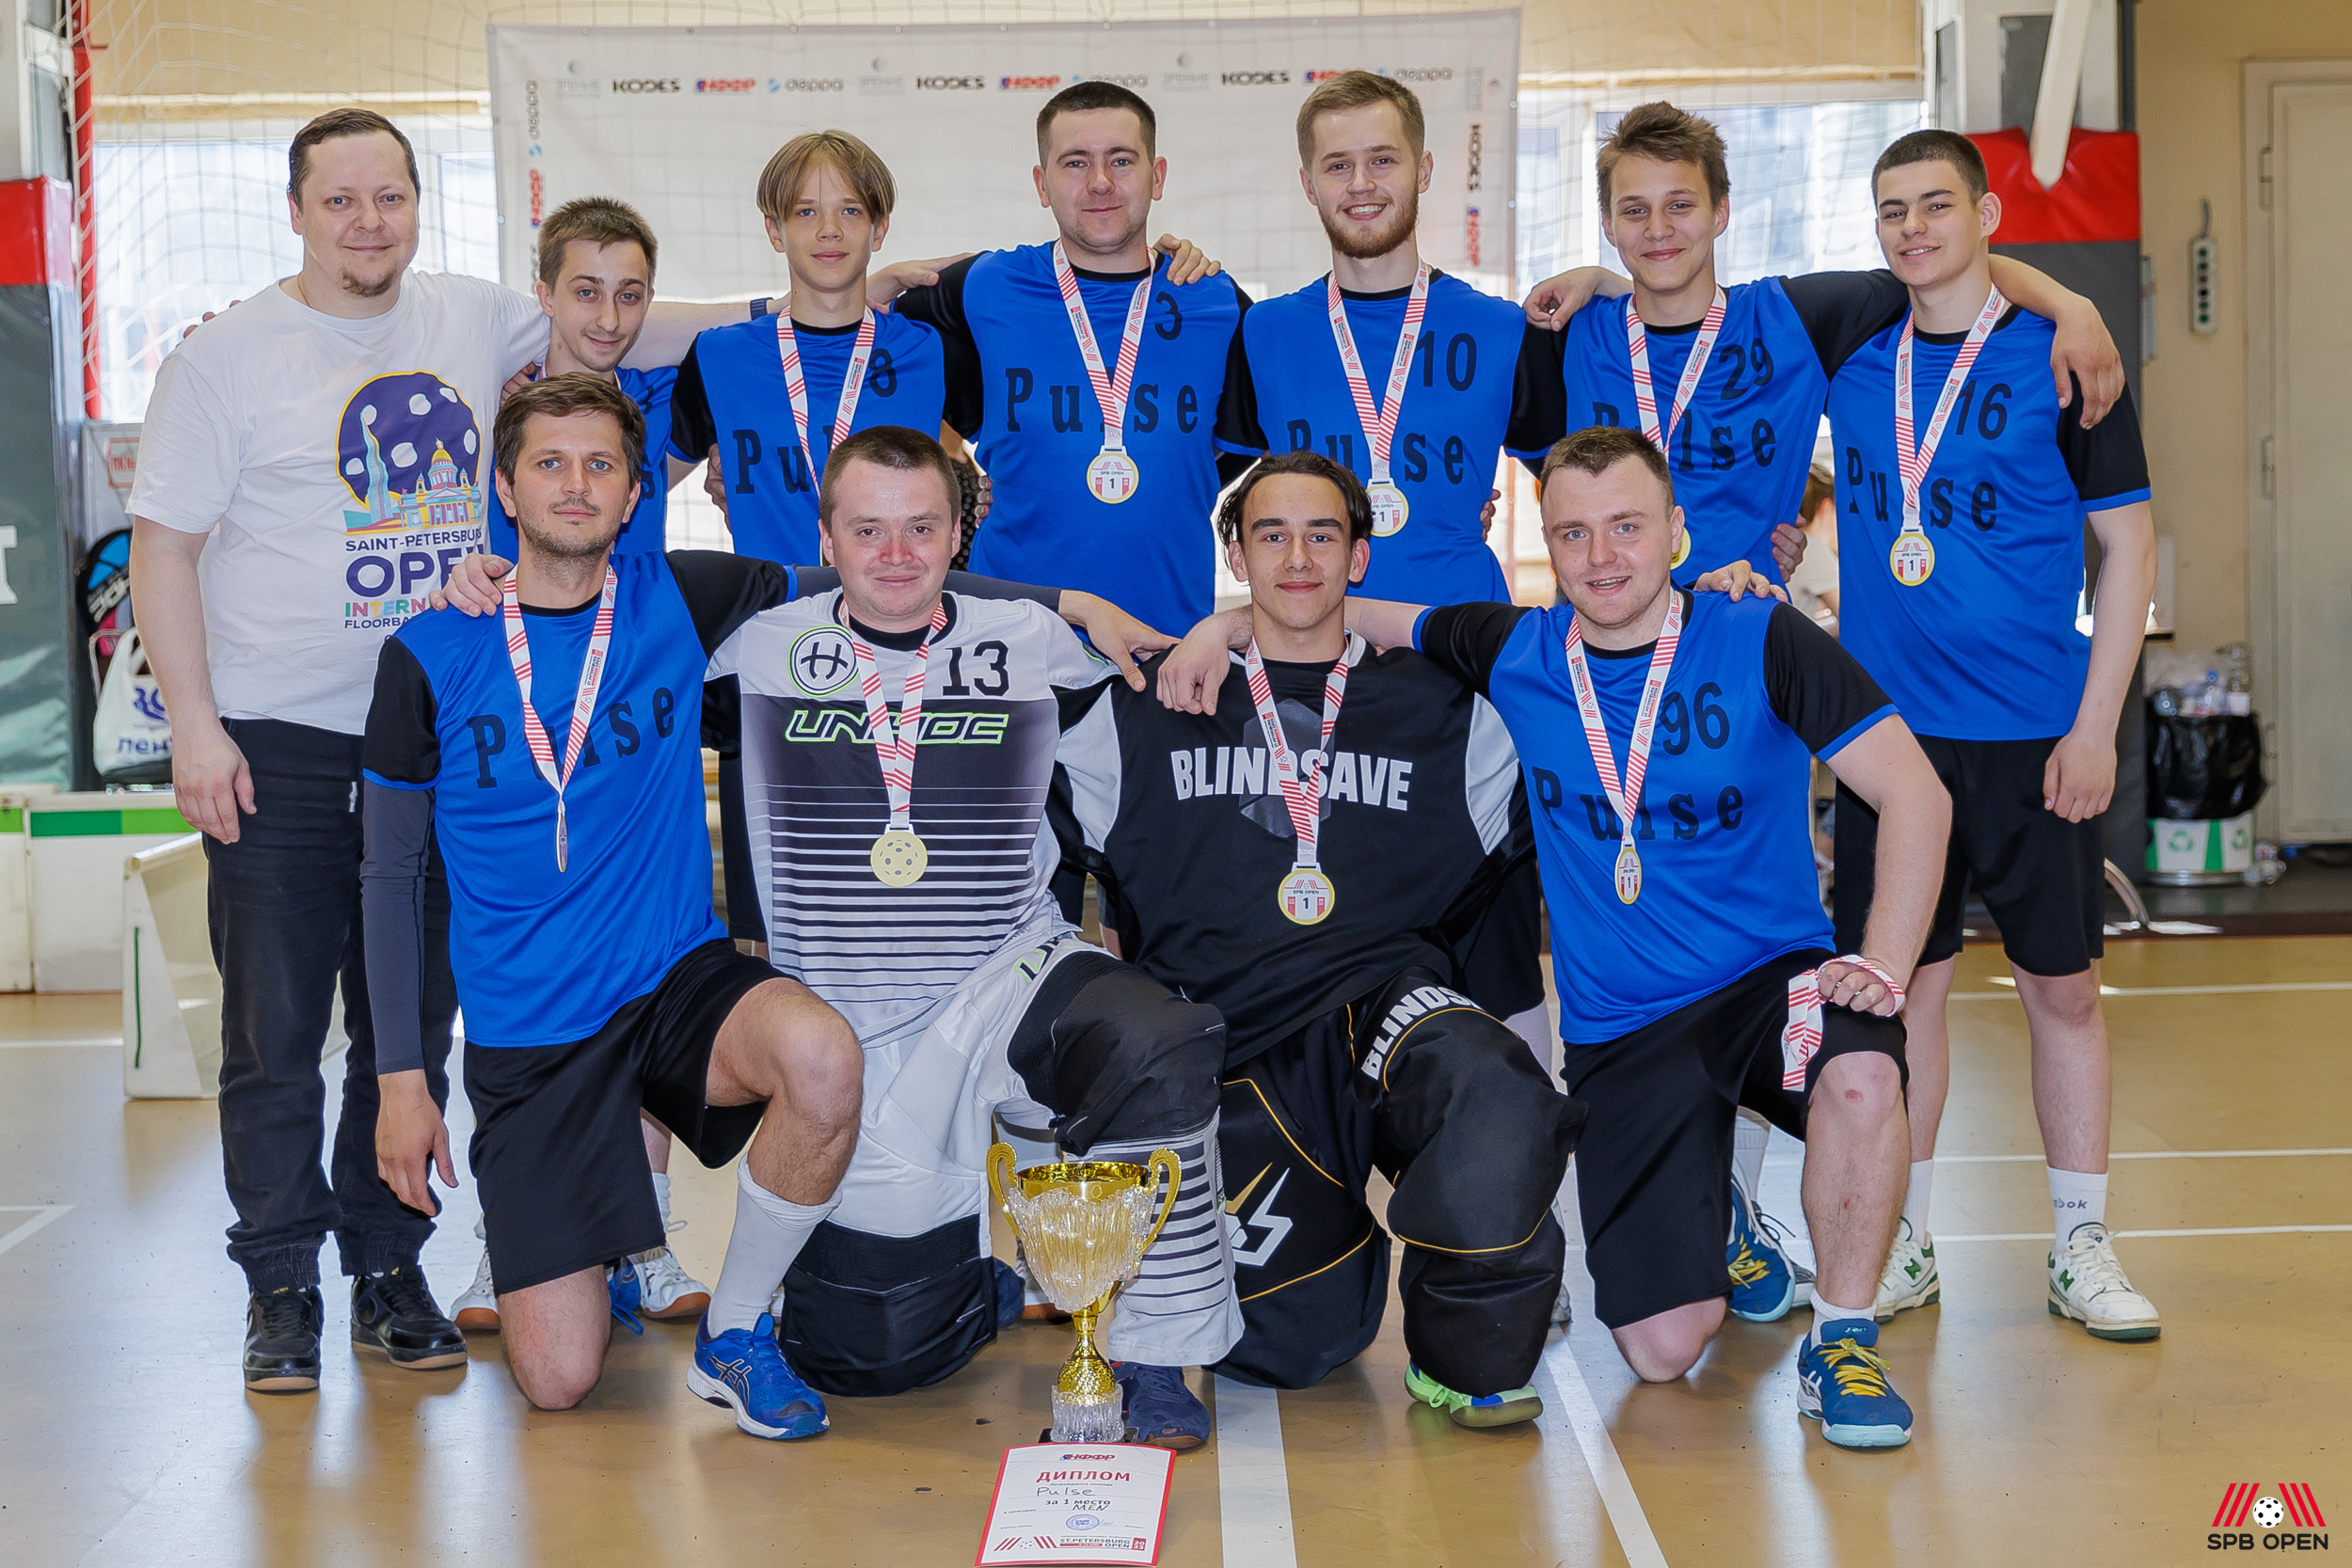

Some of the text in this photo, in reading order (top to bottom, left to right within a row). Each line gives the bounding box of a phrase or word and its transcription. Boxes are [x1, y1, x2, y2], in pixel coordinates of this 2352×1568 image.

[915, 75, 985, 90] KODES
[1221, 70, 1290, 86] KODES
[1154, 291, 1183, 341] 3
[1416, 331, 1478, 391] 10
[1719, 337, 1774, 402] 29
[1005, 368, 1199, 433] Puse
[1954, 379, 2012, 440] 16
[1287, 419, 1464, 485] Puse
[1109, 478, 1115, 489] 1
[1846, 447, 1997, 532] Puse
[1379, 511, 1385, 522] 1
[346, 544, 484, 597] OPE
[1909, 560, 1914, 571] 1
[345, 597, 429, 617] INTERN
[942, 640, 1010, 697] 13
[786, 710, 1009, 744] UNOC
[1660, 681, 1730, 755] 96
[1170, 747, 1412, 811] BLINDSAVE
[1302, 897, 1309, 909] 1
[1361, 987, 1484, 1080] BLINDS
[1036, 1470, 1131, 1483] ДИПЛОМ
[1037, 1486, 1096, 1497] Pulse
